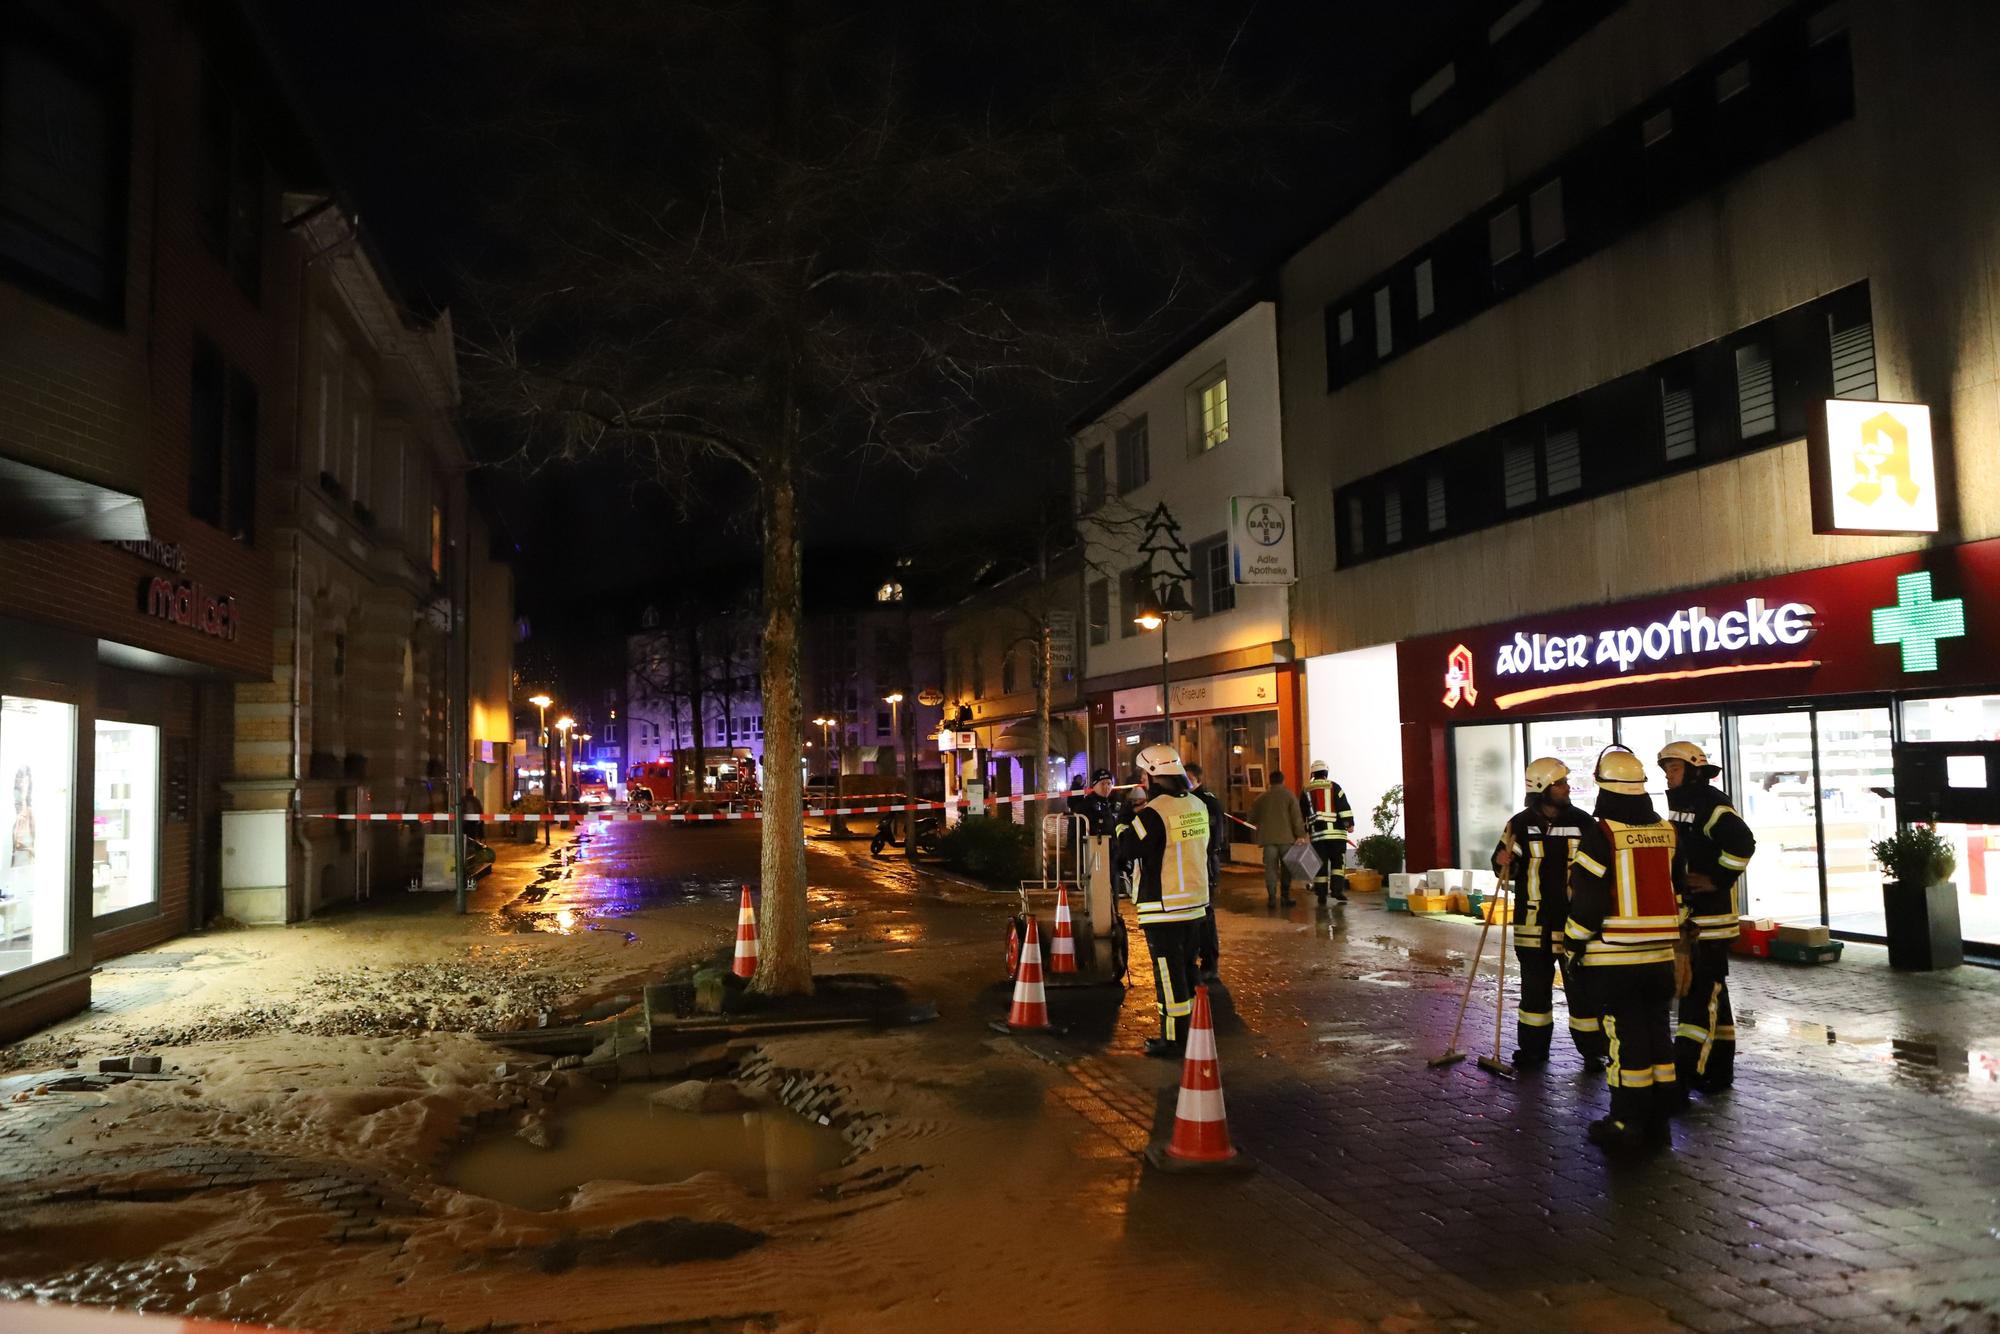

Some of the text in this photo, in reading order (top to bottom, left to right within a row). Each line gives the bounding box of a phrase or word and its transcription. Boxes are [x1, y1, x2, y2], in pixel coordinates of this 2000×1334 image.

[1250, 520, 1282, 529] BAYER
[1257, 555, 1279, 564] Adler
[1248, 566, 1288, 577] Apotheke
[1626, 833, 1665, 844] C-Dienst
